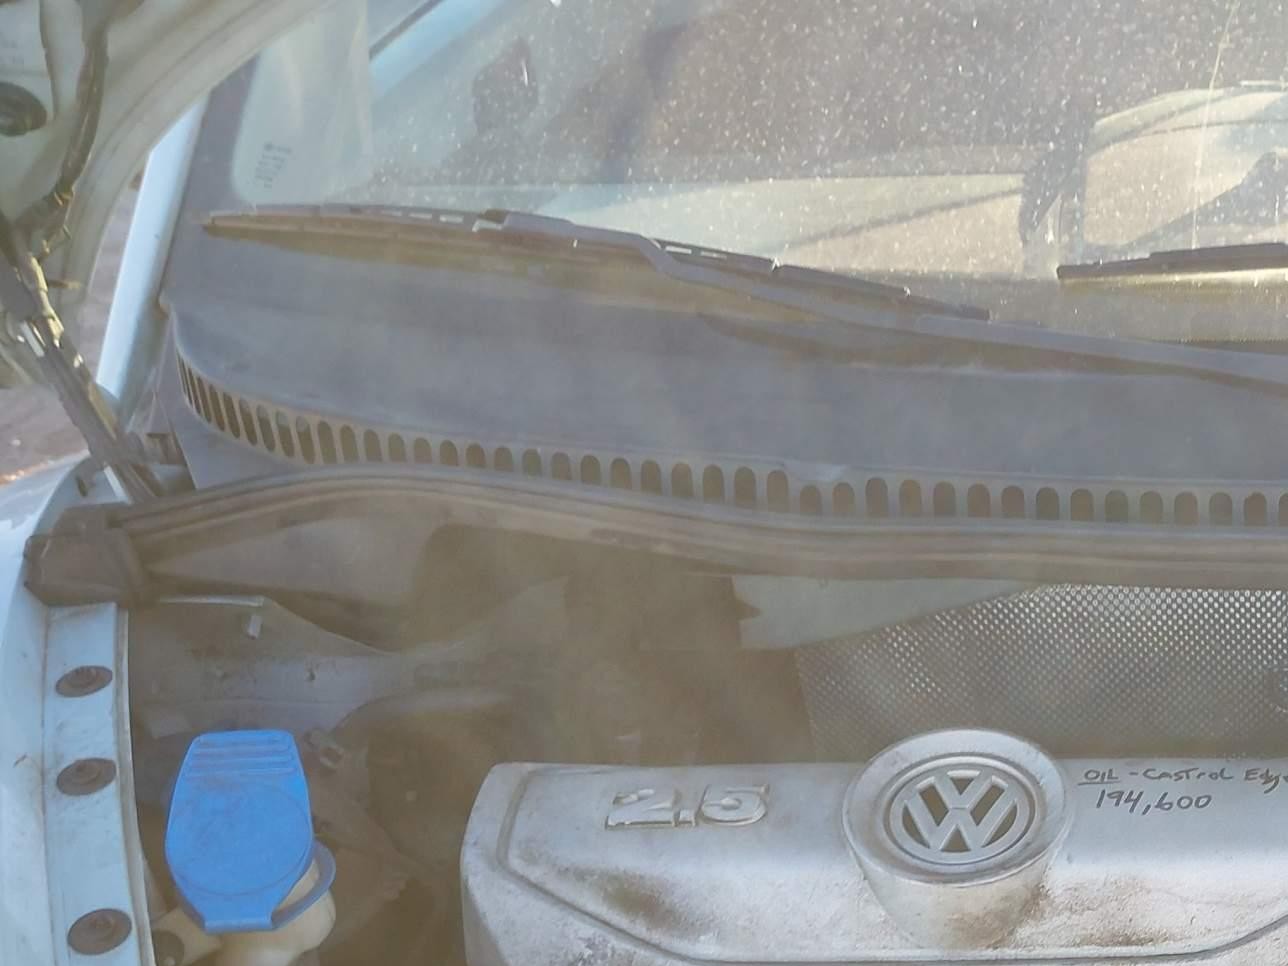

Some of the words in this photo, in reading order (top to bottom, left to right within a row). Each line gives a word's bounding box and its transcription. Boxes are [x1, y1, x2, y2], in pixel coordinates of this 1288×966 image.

[1083, 768, 1120, 783] OIL
[605, 783, 771, 830] 2.5
[1096, 787, 1213, 816] 194,600
